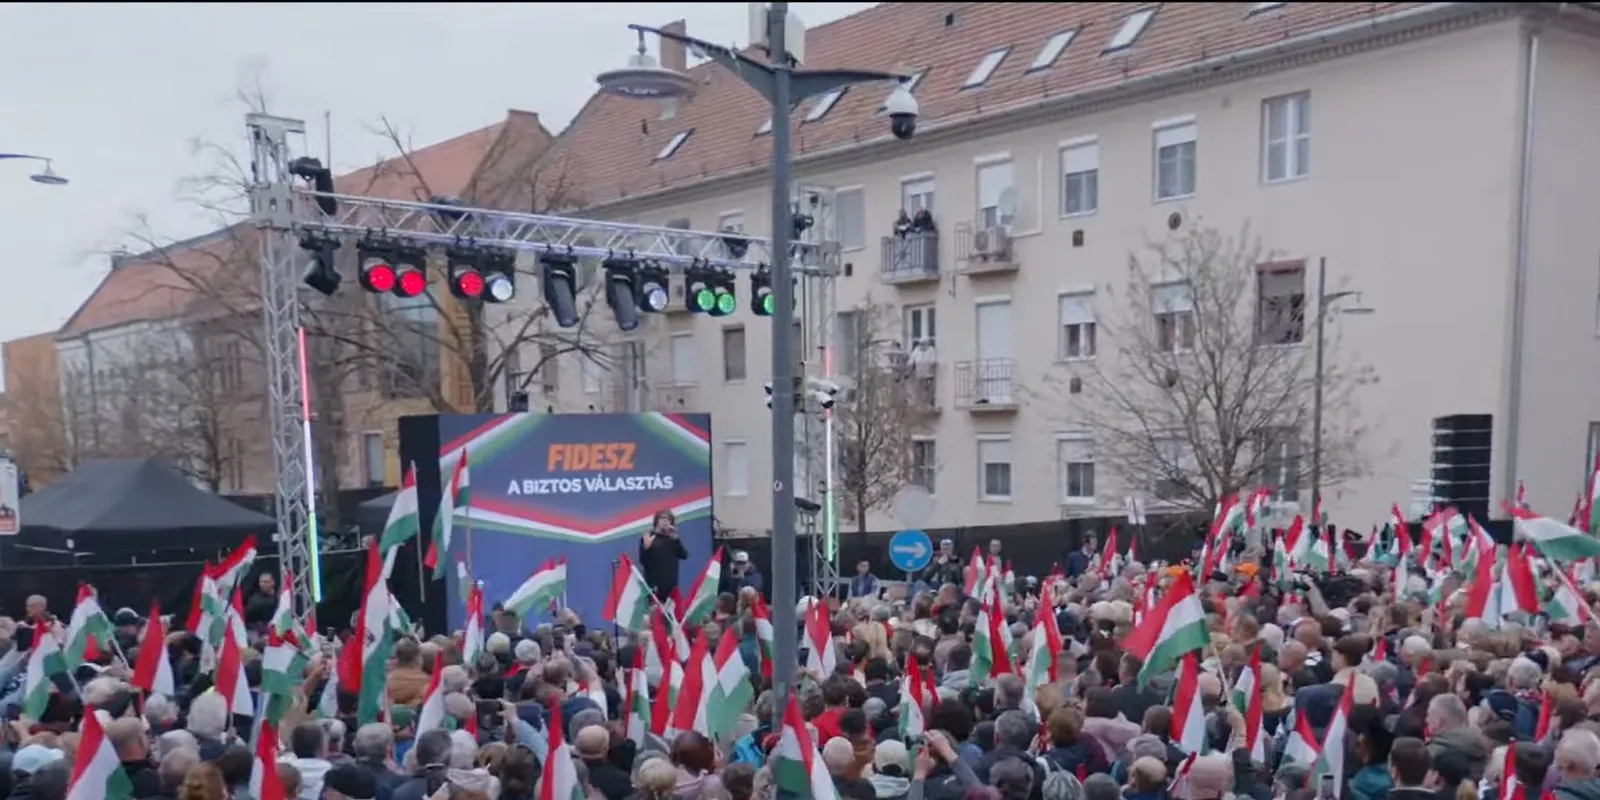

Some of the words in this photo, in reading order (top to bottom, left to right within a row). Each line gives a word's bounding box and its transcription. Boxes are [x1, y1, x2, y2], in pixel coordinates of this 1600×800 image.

[547, 443, 636, 471] FIDESZ
[507, 479, 520, 495] A
[523, 477, 582, 494] BIZTOS
[584, 473, 674, 492] VÁLASZTÁS
